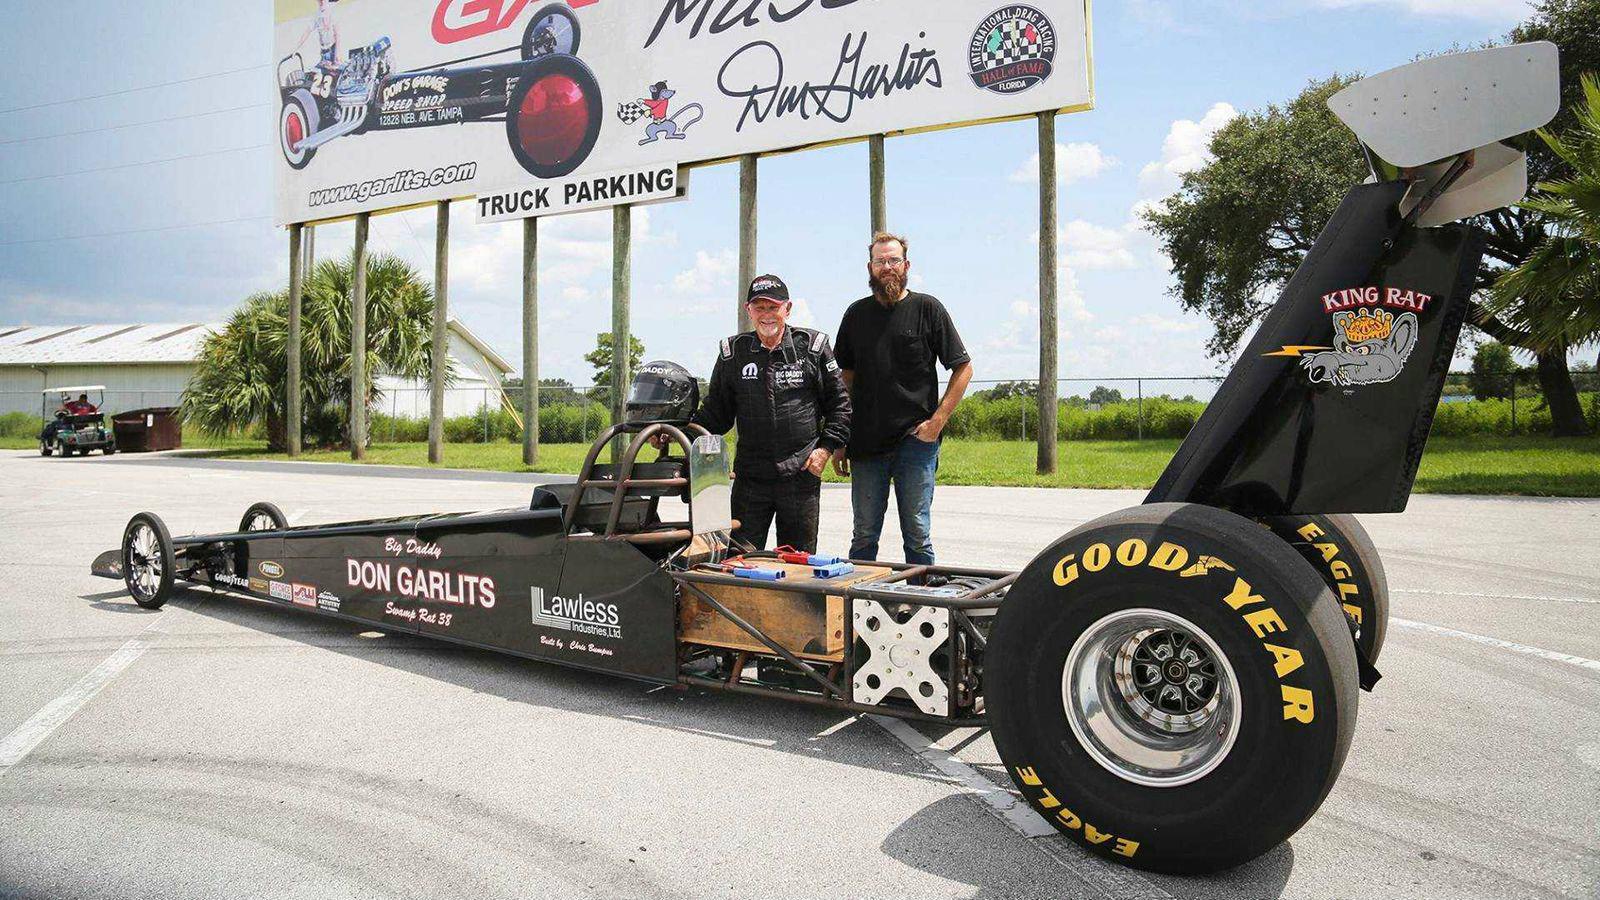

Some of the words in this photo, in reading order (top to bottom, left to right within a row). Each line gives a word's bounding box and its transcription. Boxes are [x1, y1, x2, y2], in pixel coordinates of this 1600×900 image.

[971, 9, 1012, 67] INTERNATIONAL
[1015, 8, 1039, 21] DRAG
[1036, 20, 1053, 53] RACING
[311, 73, 332, 99] 23
[807, 31, 942, 123] Garlits
[981, 68, 1007, 84] HALL
[1016, 62, 1045, 75] FAME
[998, 80, 1027, 91] FLORIDA
[382, 79, 412, 101] DON'S
[412, 75, 450, 93] GARAGE
[381, 98, 412, 112] SPEED
[414, 93, 447, 108] SHOP
[438, 107, 463, 121] TAMPA
[308, 161, 478, 207] www.garlits.com
[478, 187, 550, 218] TRUCK
[564, 167, 674, 206] PARKING
[1322, 287, 1379, 313] KING
[1386, 287, 1432, 312] RAT
[384, 537, 403, 556] Big
[405, 538, 442, 559] Daddy
[347, 558, 391, 592] DON
[396, 566, 496, 608] GARLITS
[1296, 522, 1363, 625] EAGLE
[385, 601, 417, 619] Swamp
[418, 608, 436, 624] Rat
[437, 613, 453, 627] 38
[540, 587, 619, 625] Lawless
[540, 635, 555, 646] Built
[556, 638, 564, 649] by
[569, 640, 587, 651] Chris
[1015, 765, 1140, 858] EAGLE
